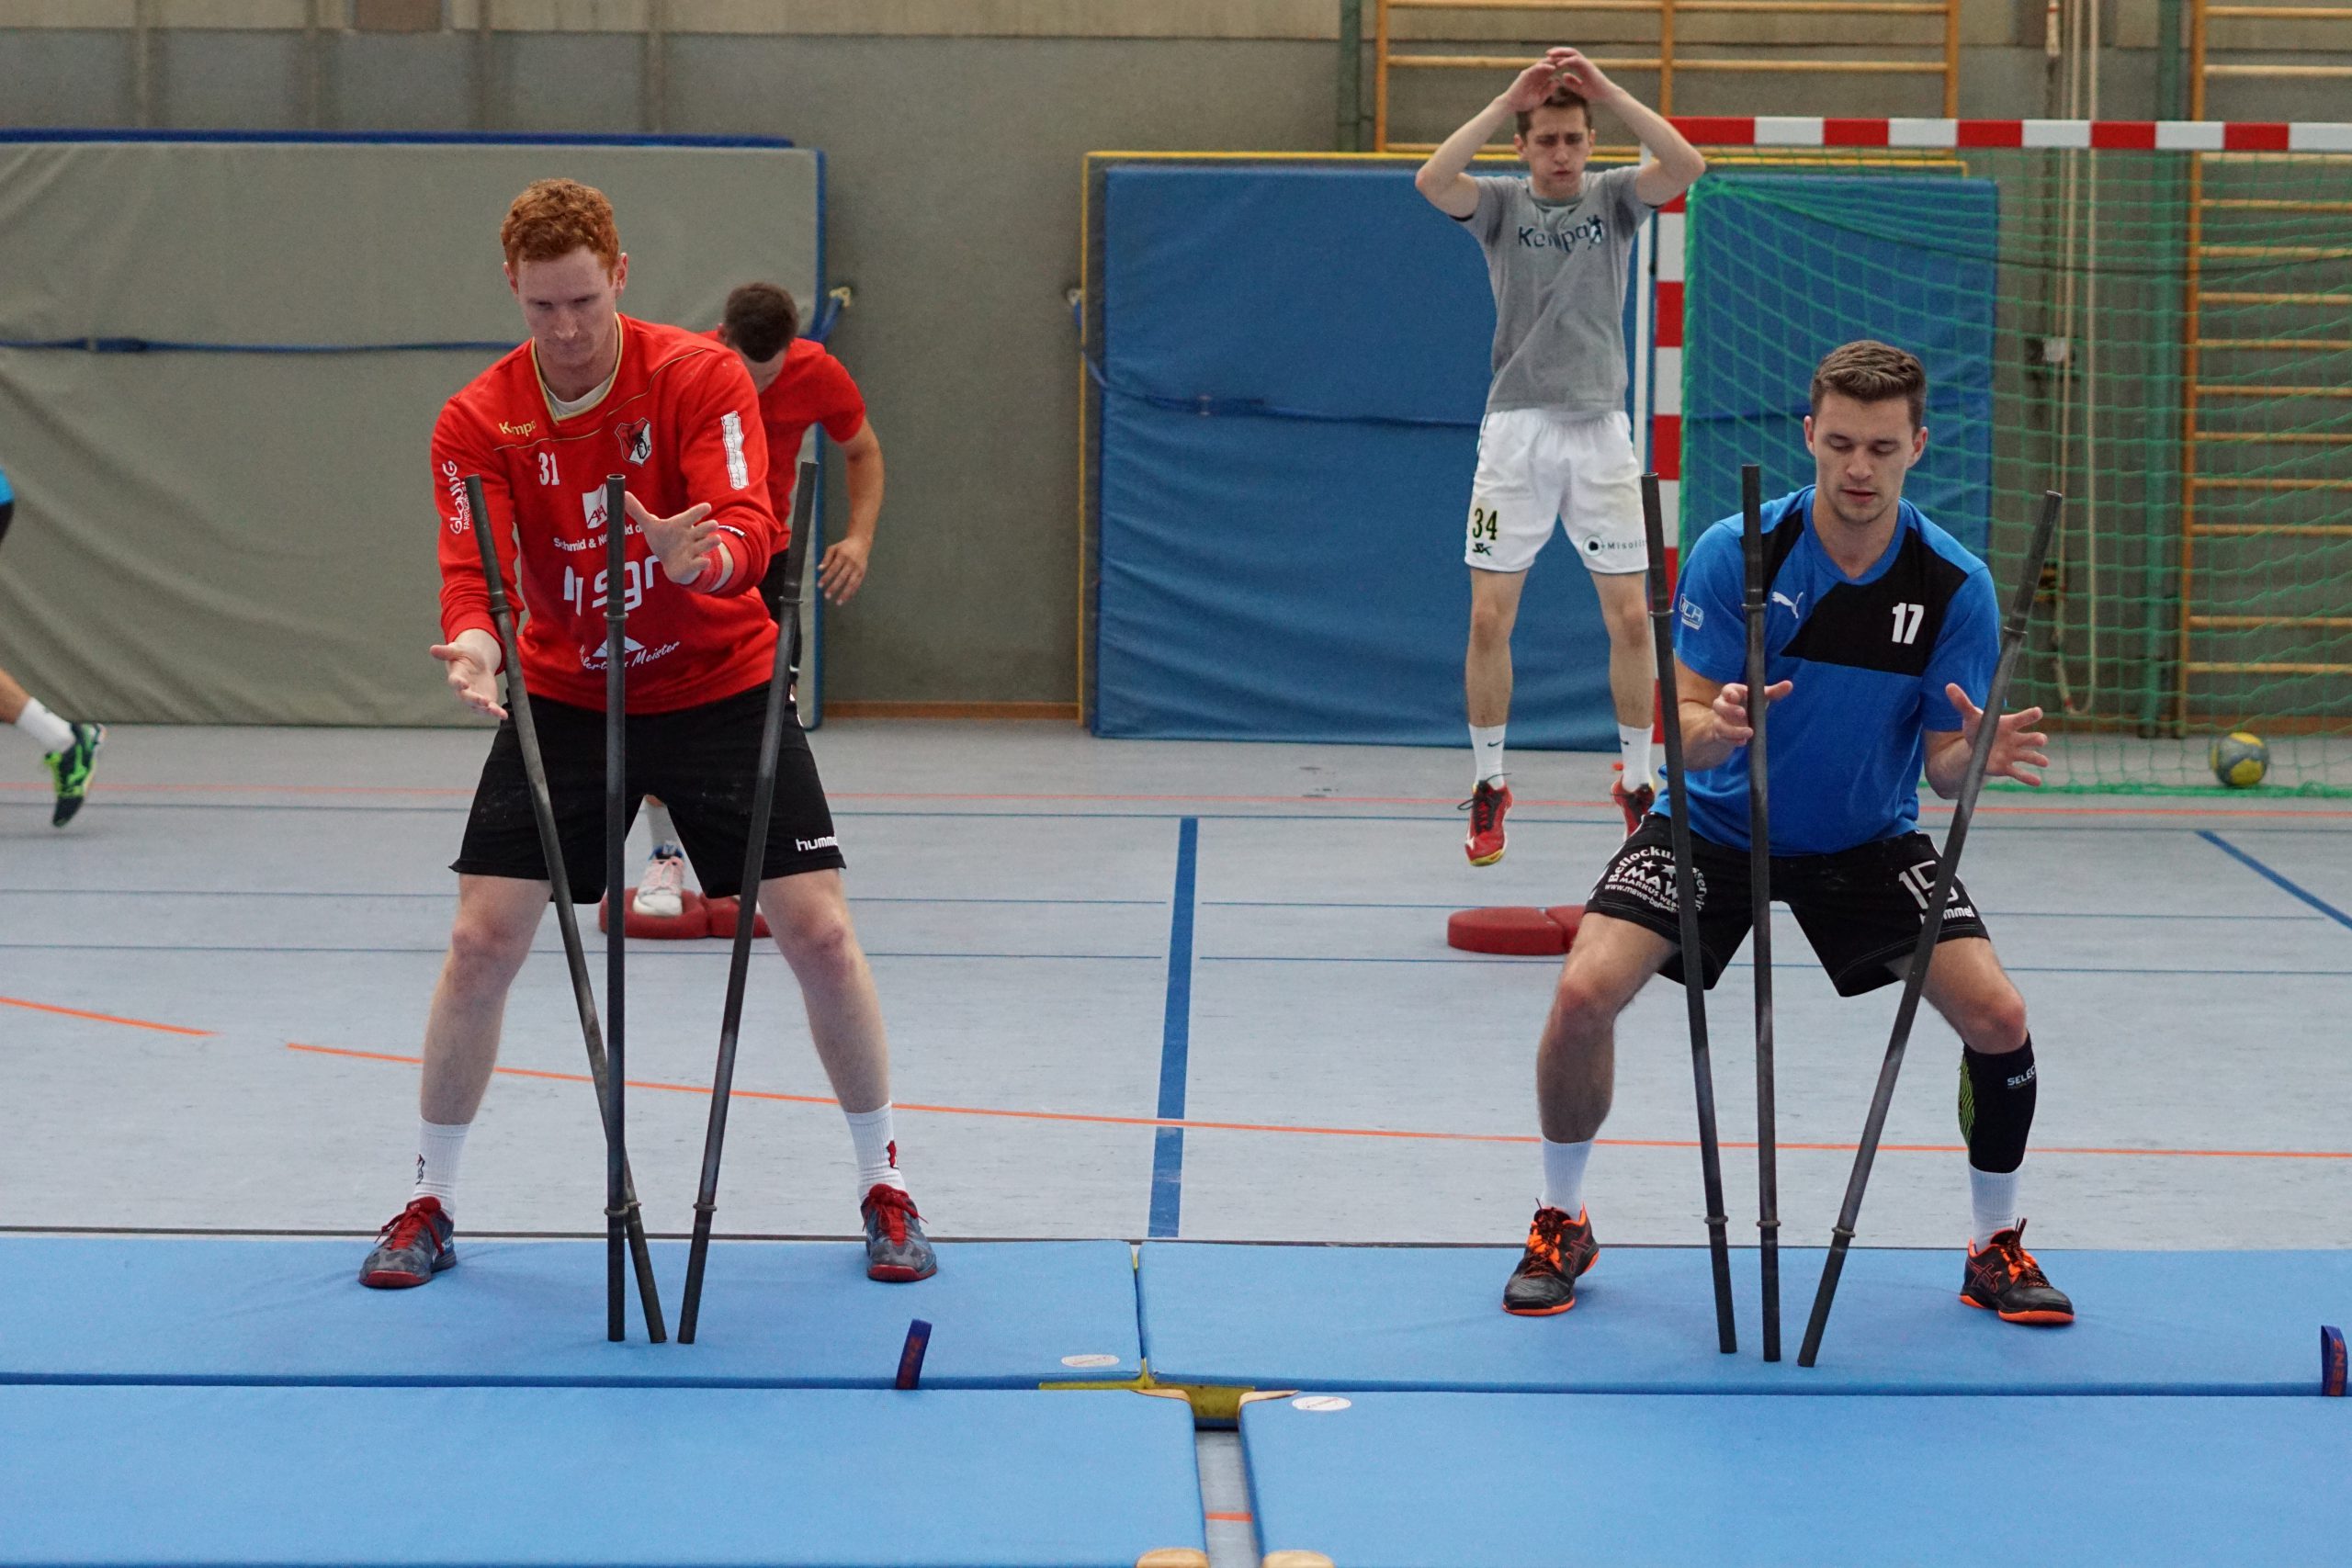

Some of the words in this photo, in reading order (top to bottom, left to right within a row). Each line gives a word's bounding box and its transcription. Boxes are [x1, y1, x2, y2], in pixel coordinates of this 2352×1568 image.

[1518, 224, 1589, 254] Kempa
[537, 452, 560, 486] 31
[1472, 508, 1498, 540] 34
[588, 537, 597, 549] &
[1891, 602, 1925, 645] 17
[631, 641, 681, 668] Meister
[1619, 877, 1660, 897] MARKUS
[1918, 905, 1975, 925] mmel
